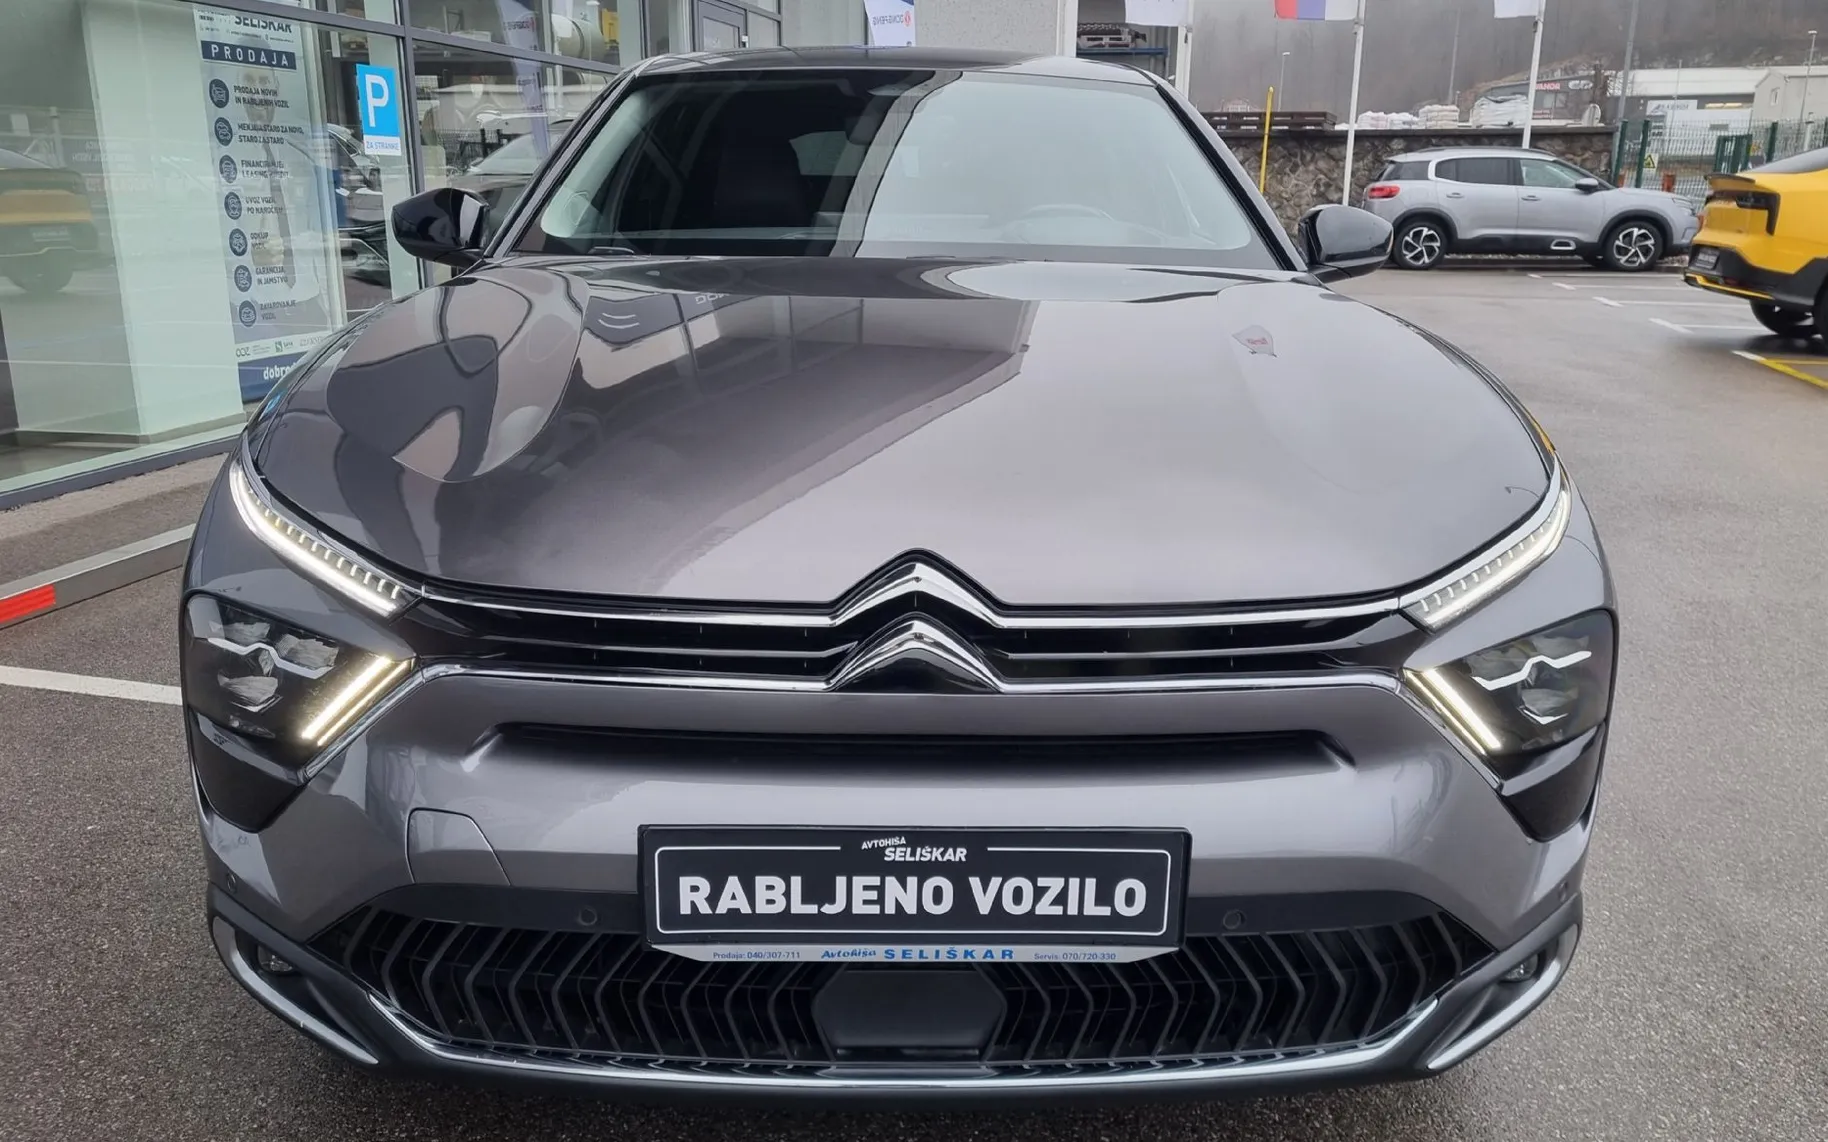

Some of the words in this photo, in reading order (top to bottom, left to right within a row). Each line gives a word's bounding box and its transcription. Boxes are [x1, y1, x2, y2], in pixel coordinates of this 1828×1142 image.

[211, 44, 289, 67] PRODAJA
[365, 74, 389, 127] P
[861, 836, 906, 850] AVTOHIŠA
[884, 846, 967, 862] SELIŠKAR
[679, 875, 954, 915] RABLJENO
[968, 876, 1147, 917] VOZILO
[713, 952, 745, 960] Prodaja:
[747, 951, 800, 959] 040/307-711
[884, 947, 1014, 960] SELIŠKAR
